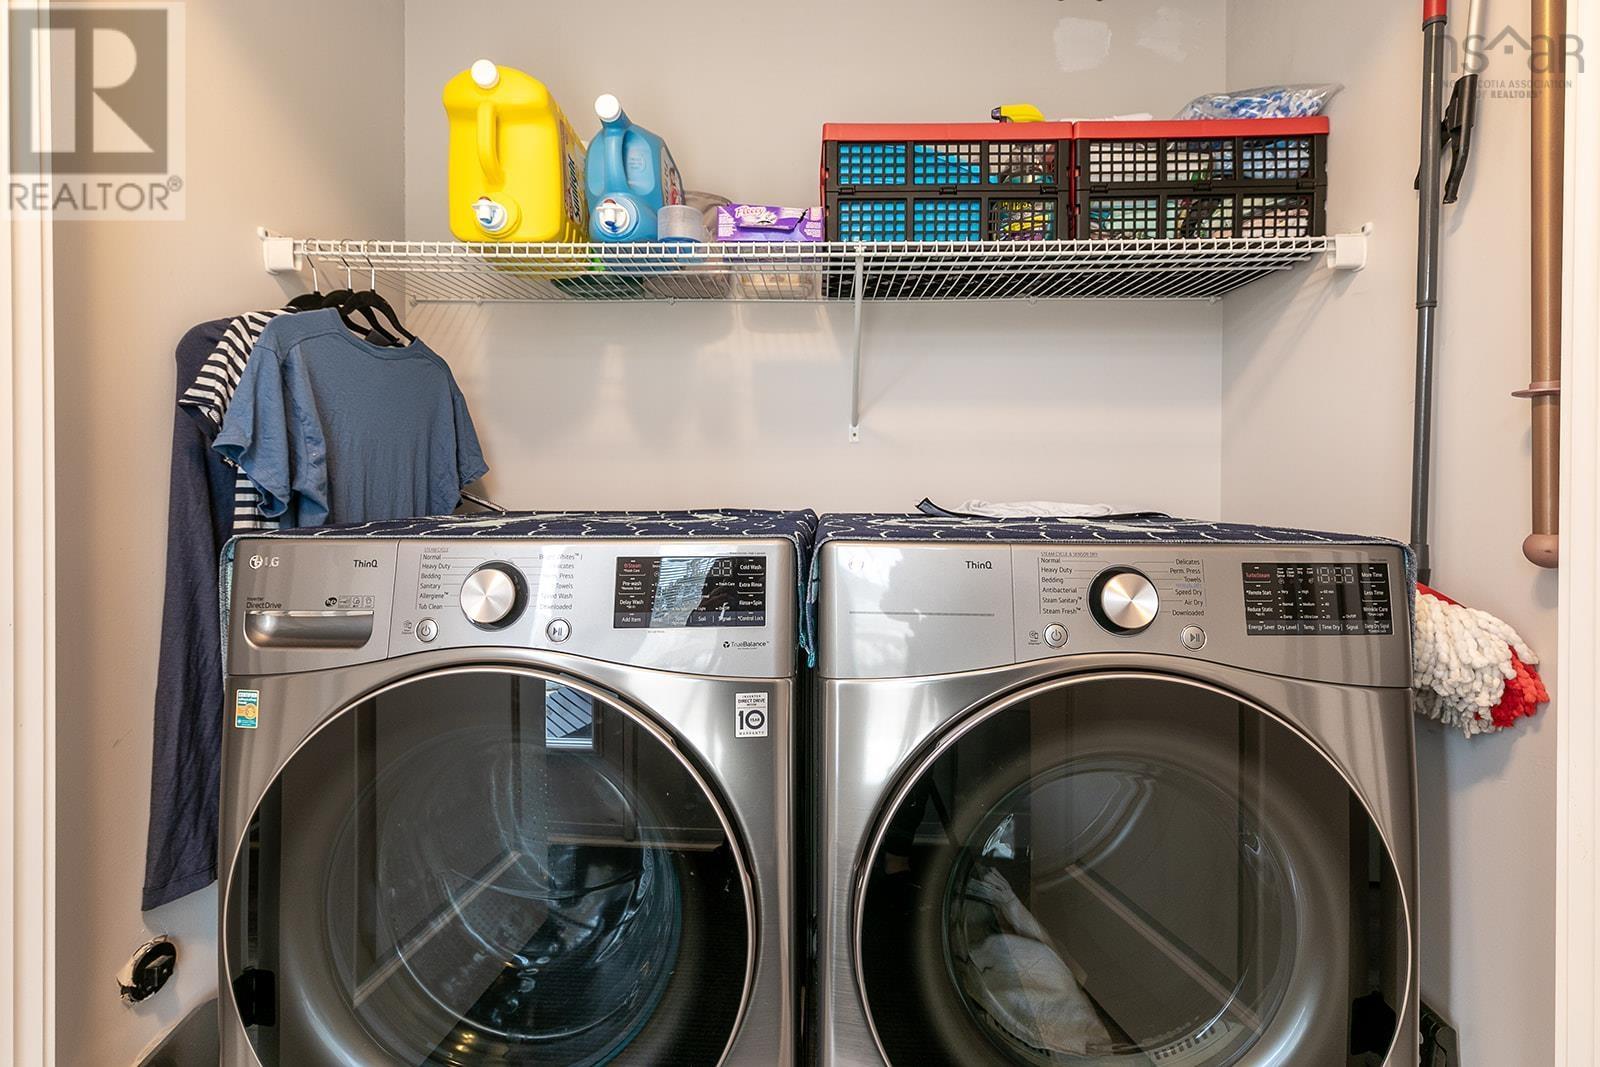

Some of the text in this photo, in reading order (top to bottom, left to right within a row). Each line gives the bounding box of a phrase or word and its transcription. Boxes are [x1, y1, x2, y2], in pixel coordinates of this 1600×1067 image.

[353, 560, 378, 568] ThinQ
[965, 560, 992, 569] ThinQ
[739, 710, 765, 730] 10
